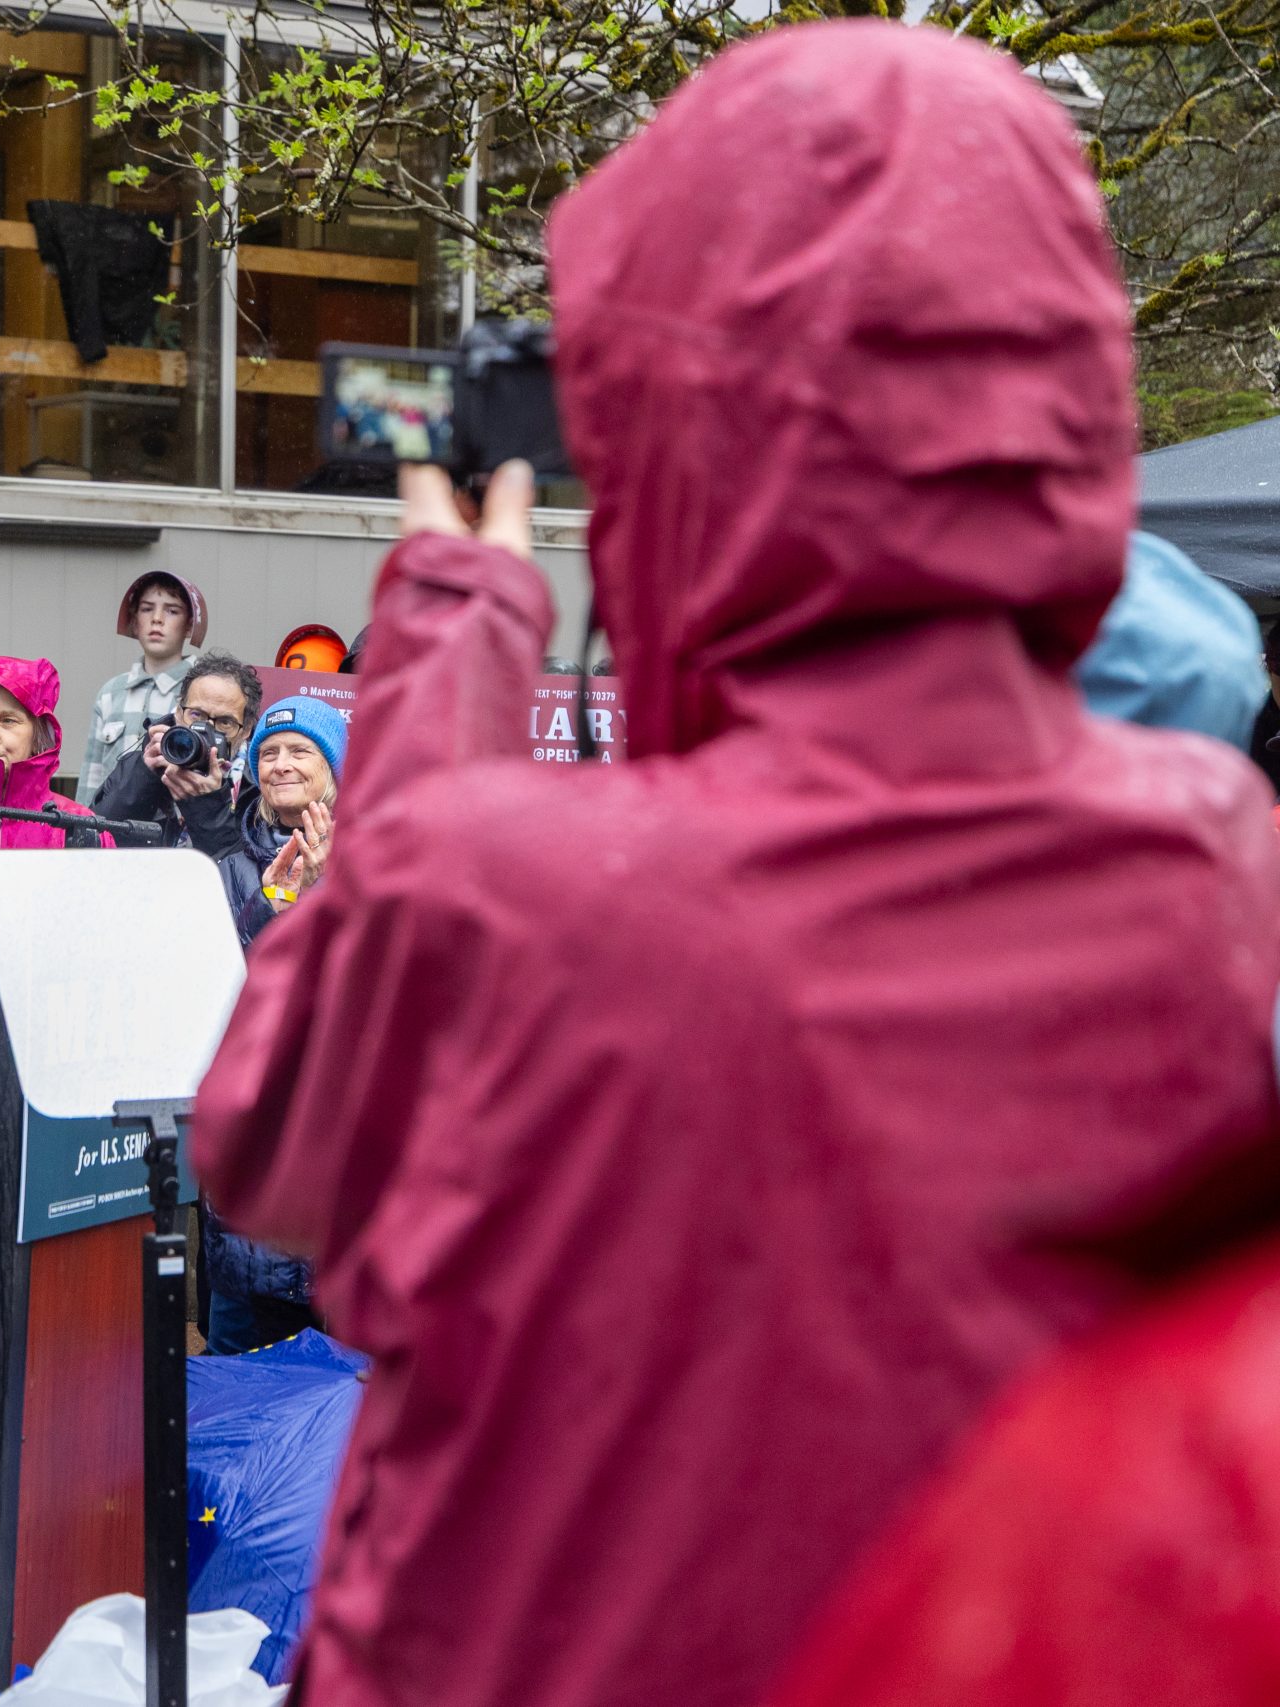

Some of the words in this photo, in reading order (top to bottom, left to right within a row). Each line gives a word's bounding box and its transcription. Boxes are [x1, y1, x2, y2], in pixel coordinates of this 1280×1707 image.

[535, 689, 550, 699] TEXT
[552, 689, 577, 700] "FISH"
[592, 691, 616, 701] 70379
[546, 748, 612, 764] PELTA
[75, 1146, 98, 1176] for
[101, 1137, 121, 1166] U.S.
